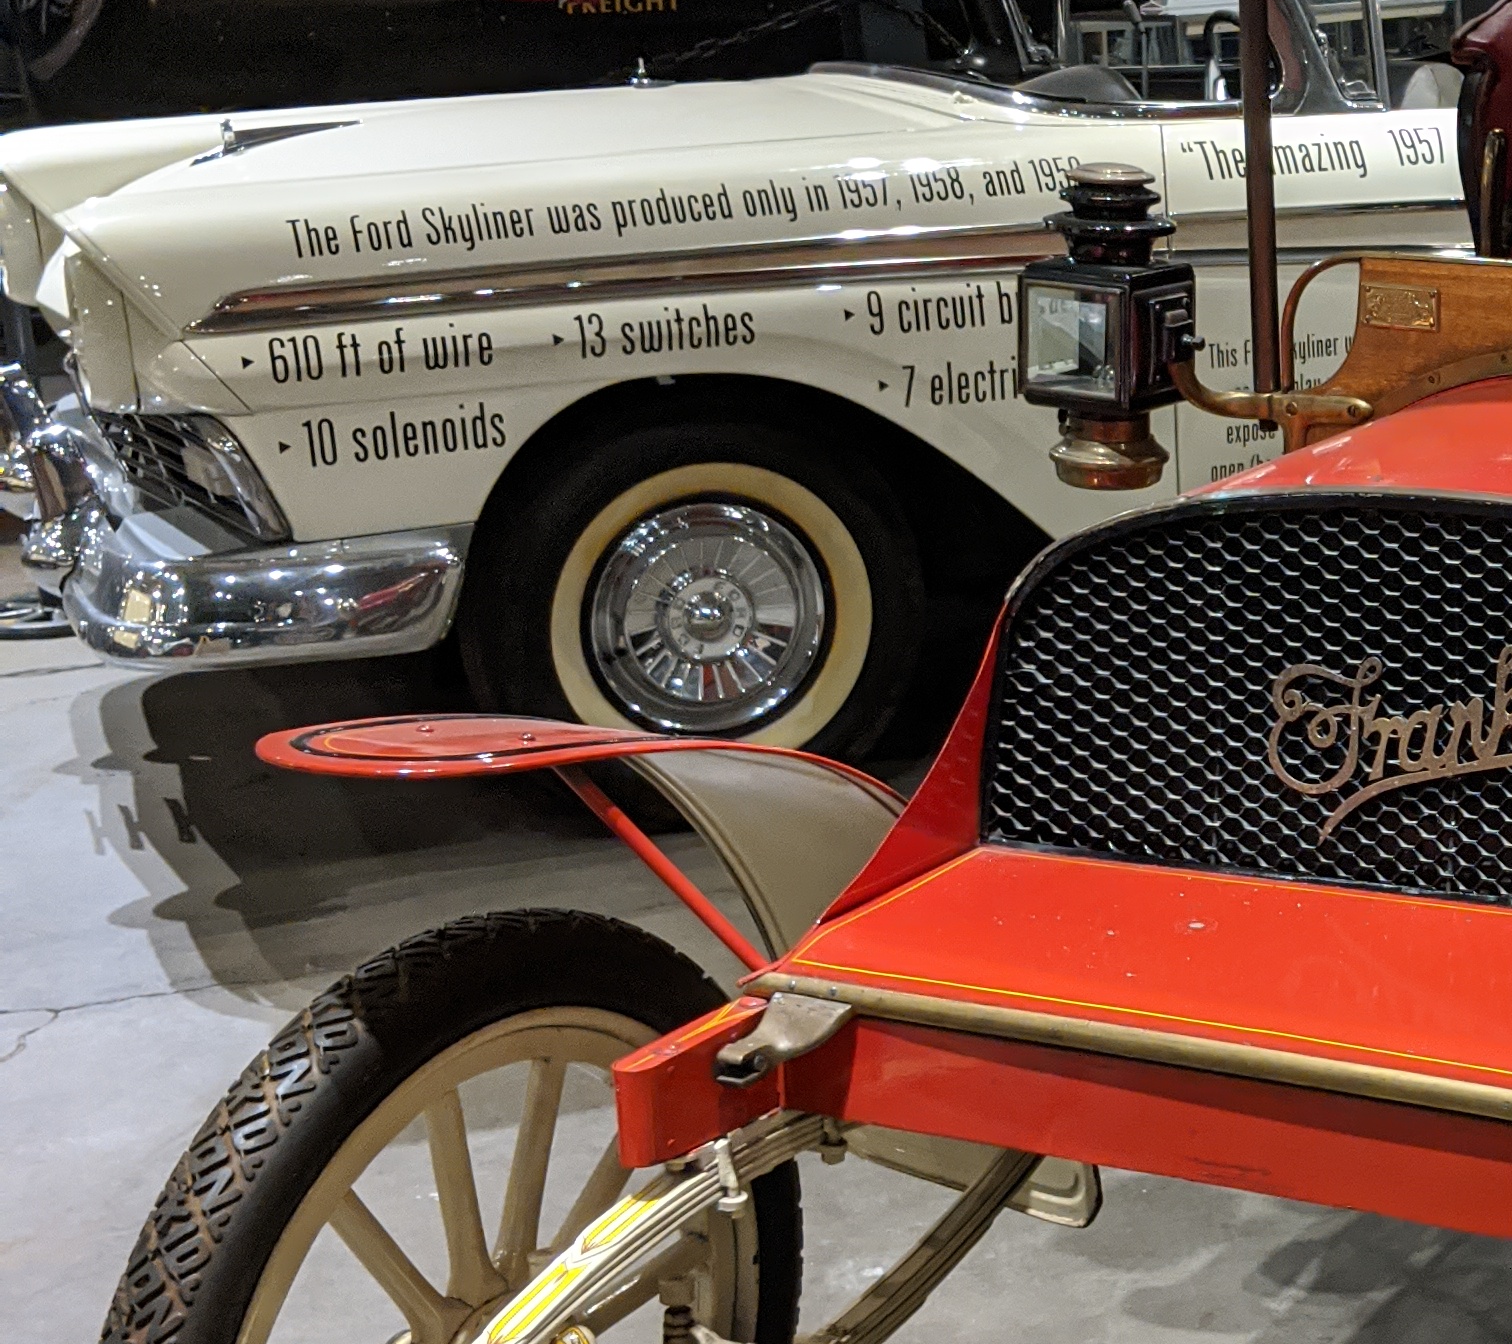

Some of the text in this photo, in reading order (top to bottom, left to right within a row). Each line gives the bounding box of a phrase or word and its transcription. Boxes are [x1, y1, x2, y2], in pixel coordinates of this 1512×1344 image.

[1271, 133, 1368, 178] mazing
[1387, 127, 1446, 167] 1957
[285, 218, 340, 258] The
[350, 210, 414, 253] Ford
[421, 202, 535, 251] Skyliner
[546, 202, 603, 235] was
[611, 183, 734, 237] produced
[741, 179, 798, 222] only
[801, 176, 830, 213] in
[834, 170, 902, 211] 1957,
[908, 164, 975, 205] 1958,
[982, 160, 1026, 197] and
[573, 303, 756, 359] 13 switches
[866, 290, 885, 336] 9
[898, 282, 986, 334] circuit
[268, 322, 494, 384] 610 ft of wire
[1208, 341, 1238, 369] This
[1294, 333, 1339, 366] yliner
[902, 355, 1018, 408] 7 electri
[302, 401, 507, 468] 10 solenoids
